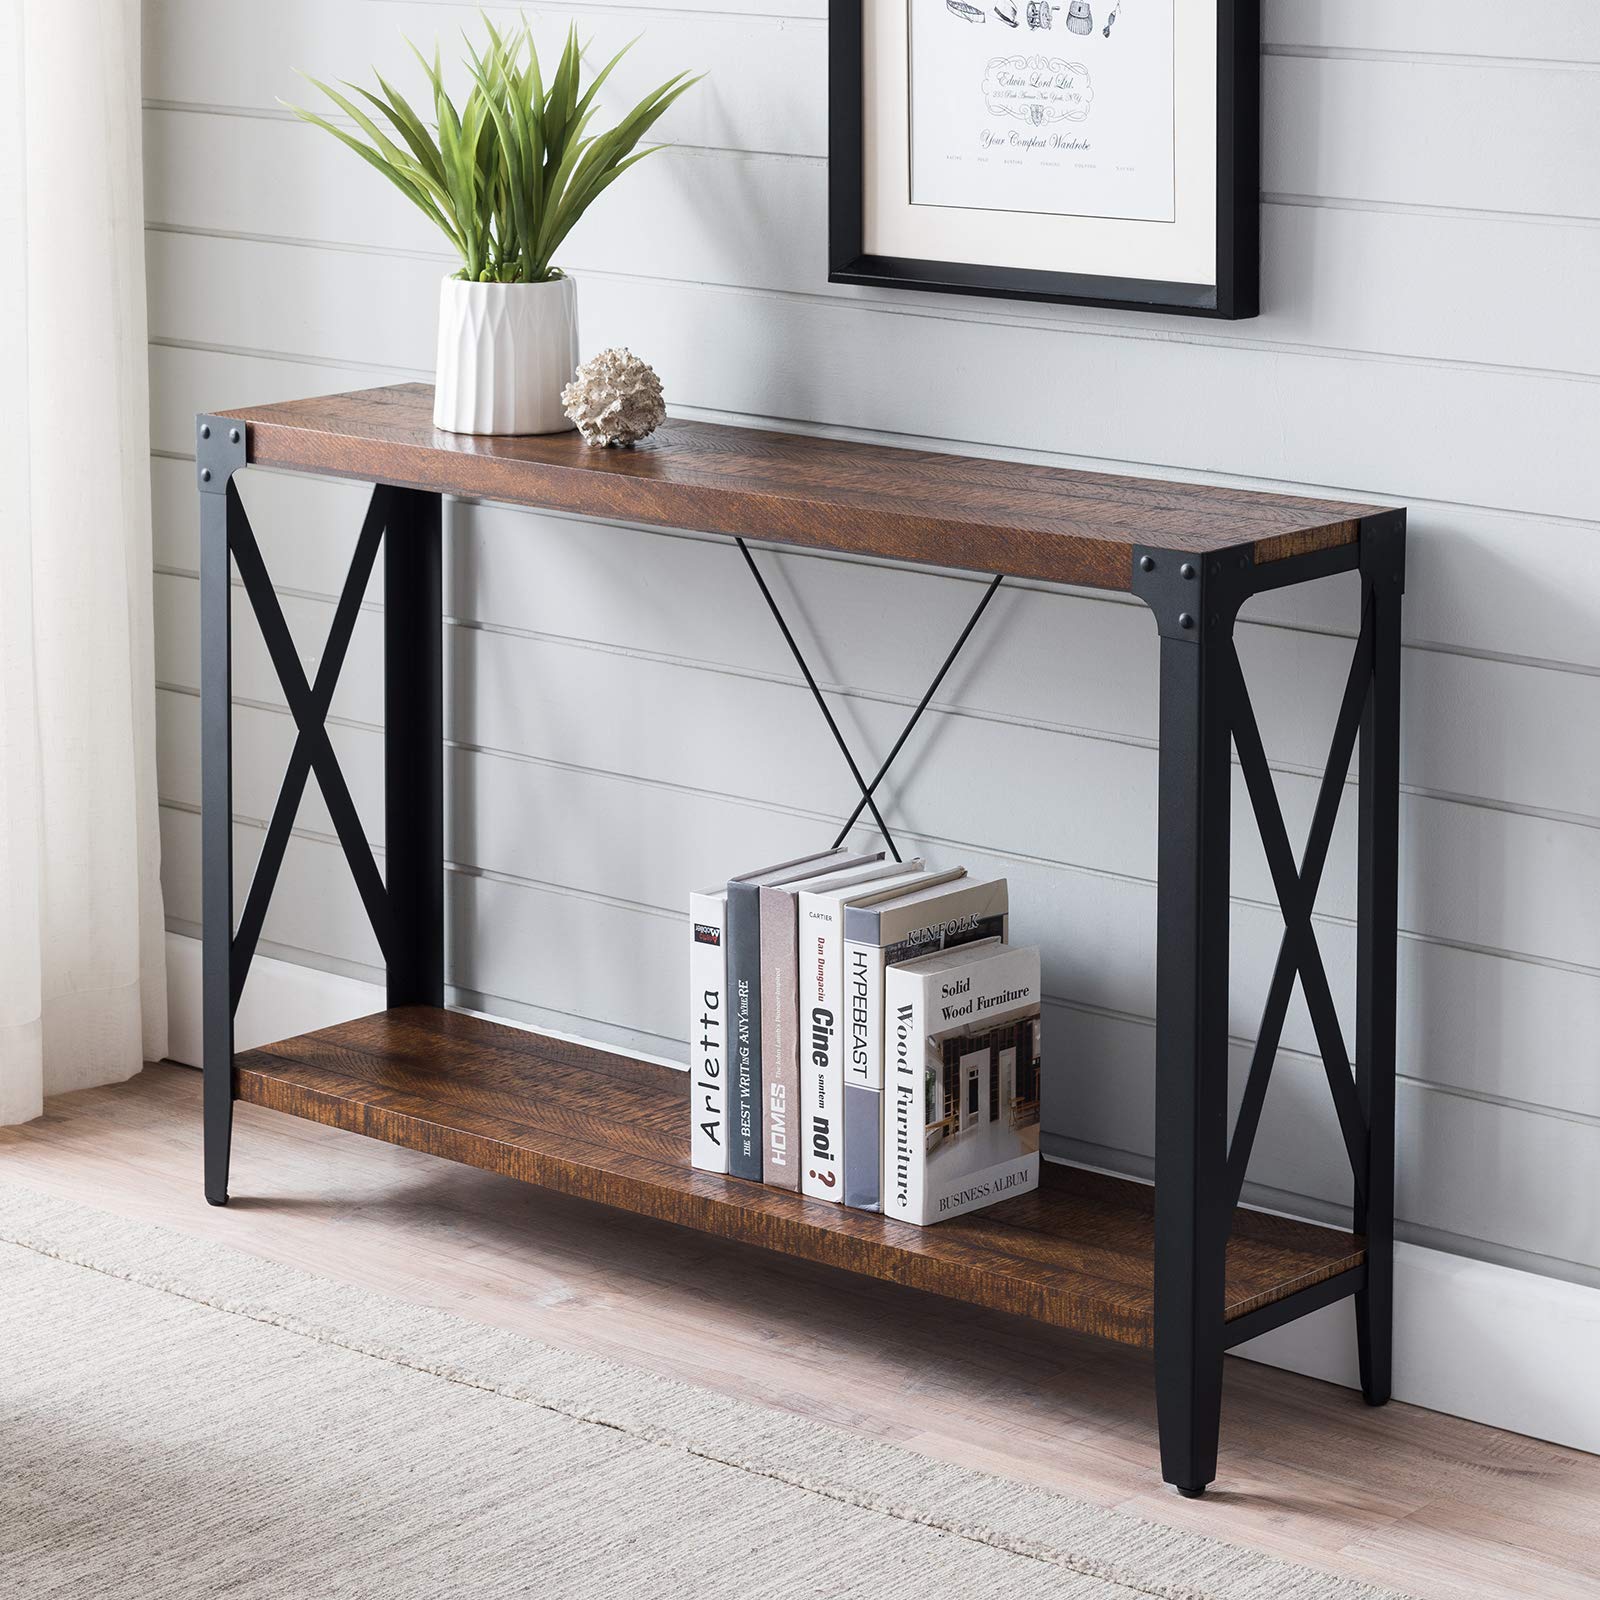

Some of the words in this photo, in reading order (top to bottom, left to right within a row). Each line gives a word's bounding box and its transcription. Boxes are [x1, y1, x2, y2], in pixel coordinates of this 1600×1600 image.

[997, 71, 1025, 87] Edwin
[1029, 71, 1053, 88] Lord
[1054, 73, 1074, 89] Ltd.
[980, 129, 1005, 148] Your
[1008, 130, 1047, 152] Compleat
[1050, 132, 1091, 151] Wardrobe
[809, 912, 833, 922] CARTIER
[906, 913, 980, 947] KINFOLK
[817, 937, 825, 955] Dan
[816, 958, 825, 1002] Dungaciu
[941, 978, 970, 999] Solid
[853, 951, 867, 1078] HYPEBEAST
[941, 999, 973, 1021] Wood
[976, 987, 1030, 1011] Furniture
[812, 1008, 834, 1068] Cine
[897, 1003, 913, 1075] Wood
[697, 990, 721, 1146] Arletta
[739, 1047, 751, 1098] WRITING
[740, 1101, 751, 1137] BEST
[770, 1083, 786, 1166] HOMES
[813, 1116, 835, 1161] noi
[743, 1140, 751, 1157] THE
[897, 1085, 913, 1207] Furniture
[809, 1169, 836, 1188] ?
[939, 1182, 990, 1212] BUSINESS
[992, 1169, 1029, 1192] ALBUM
